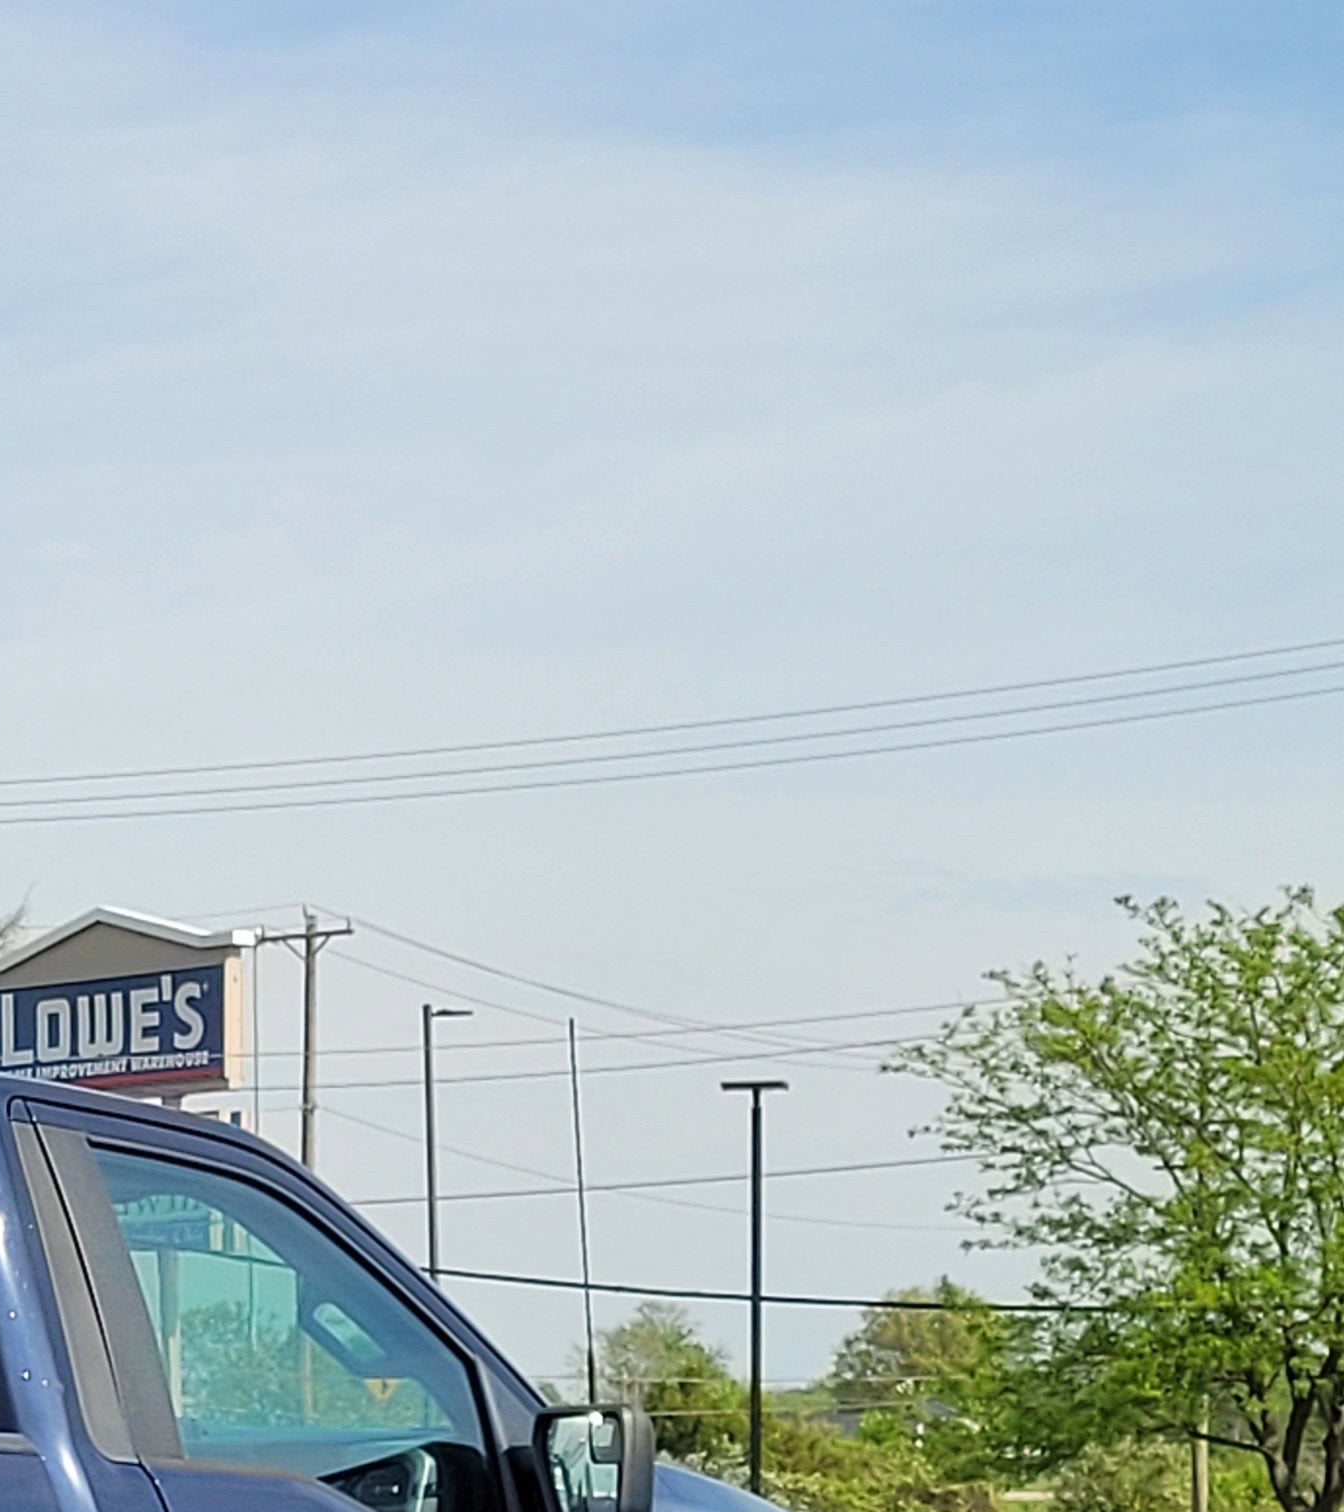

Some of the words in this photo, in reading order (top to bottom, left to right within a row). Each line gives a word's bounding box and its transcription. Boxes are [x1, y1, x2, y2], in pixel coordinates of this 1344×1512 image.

[0, 974, 206, 1067] LOWE'S
[35, 1056, 127, 1080] IMPROVEMENT
[130, 1050, 209, 1072] WAREHOUSE
